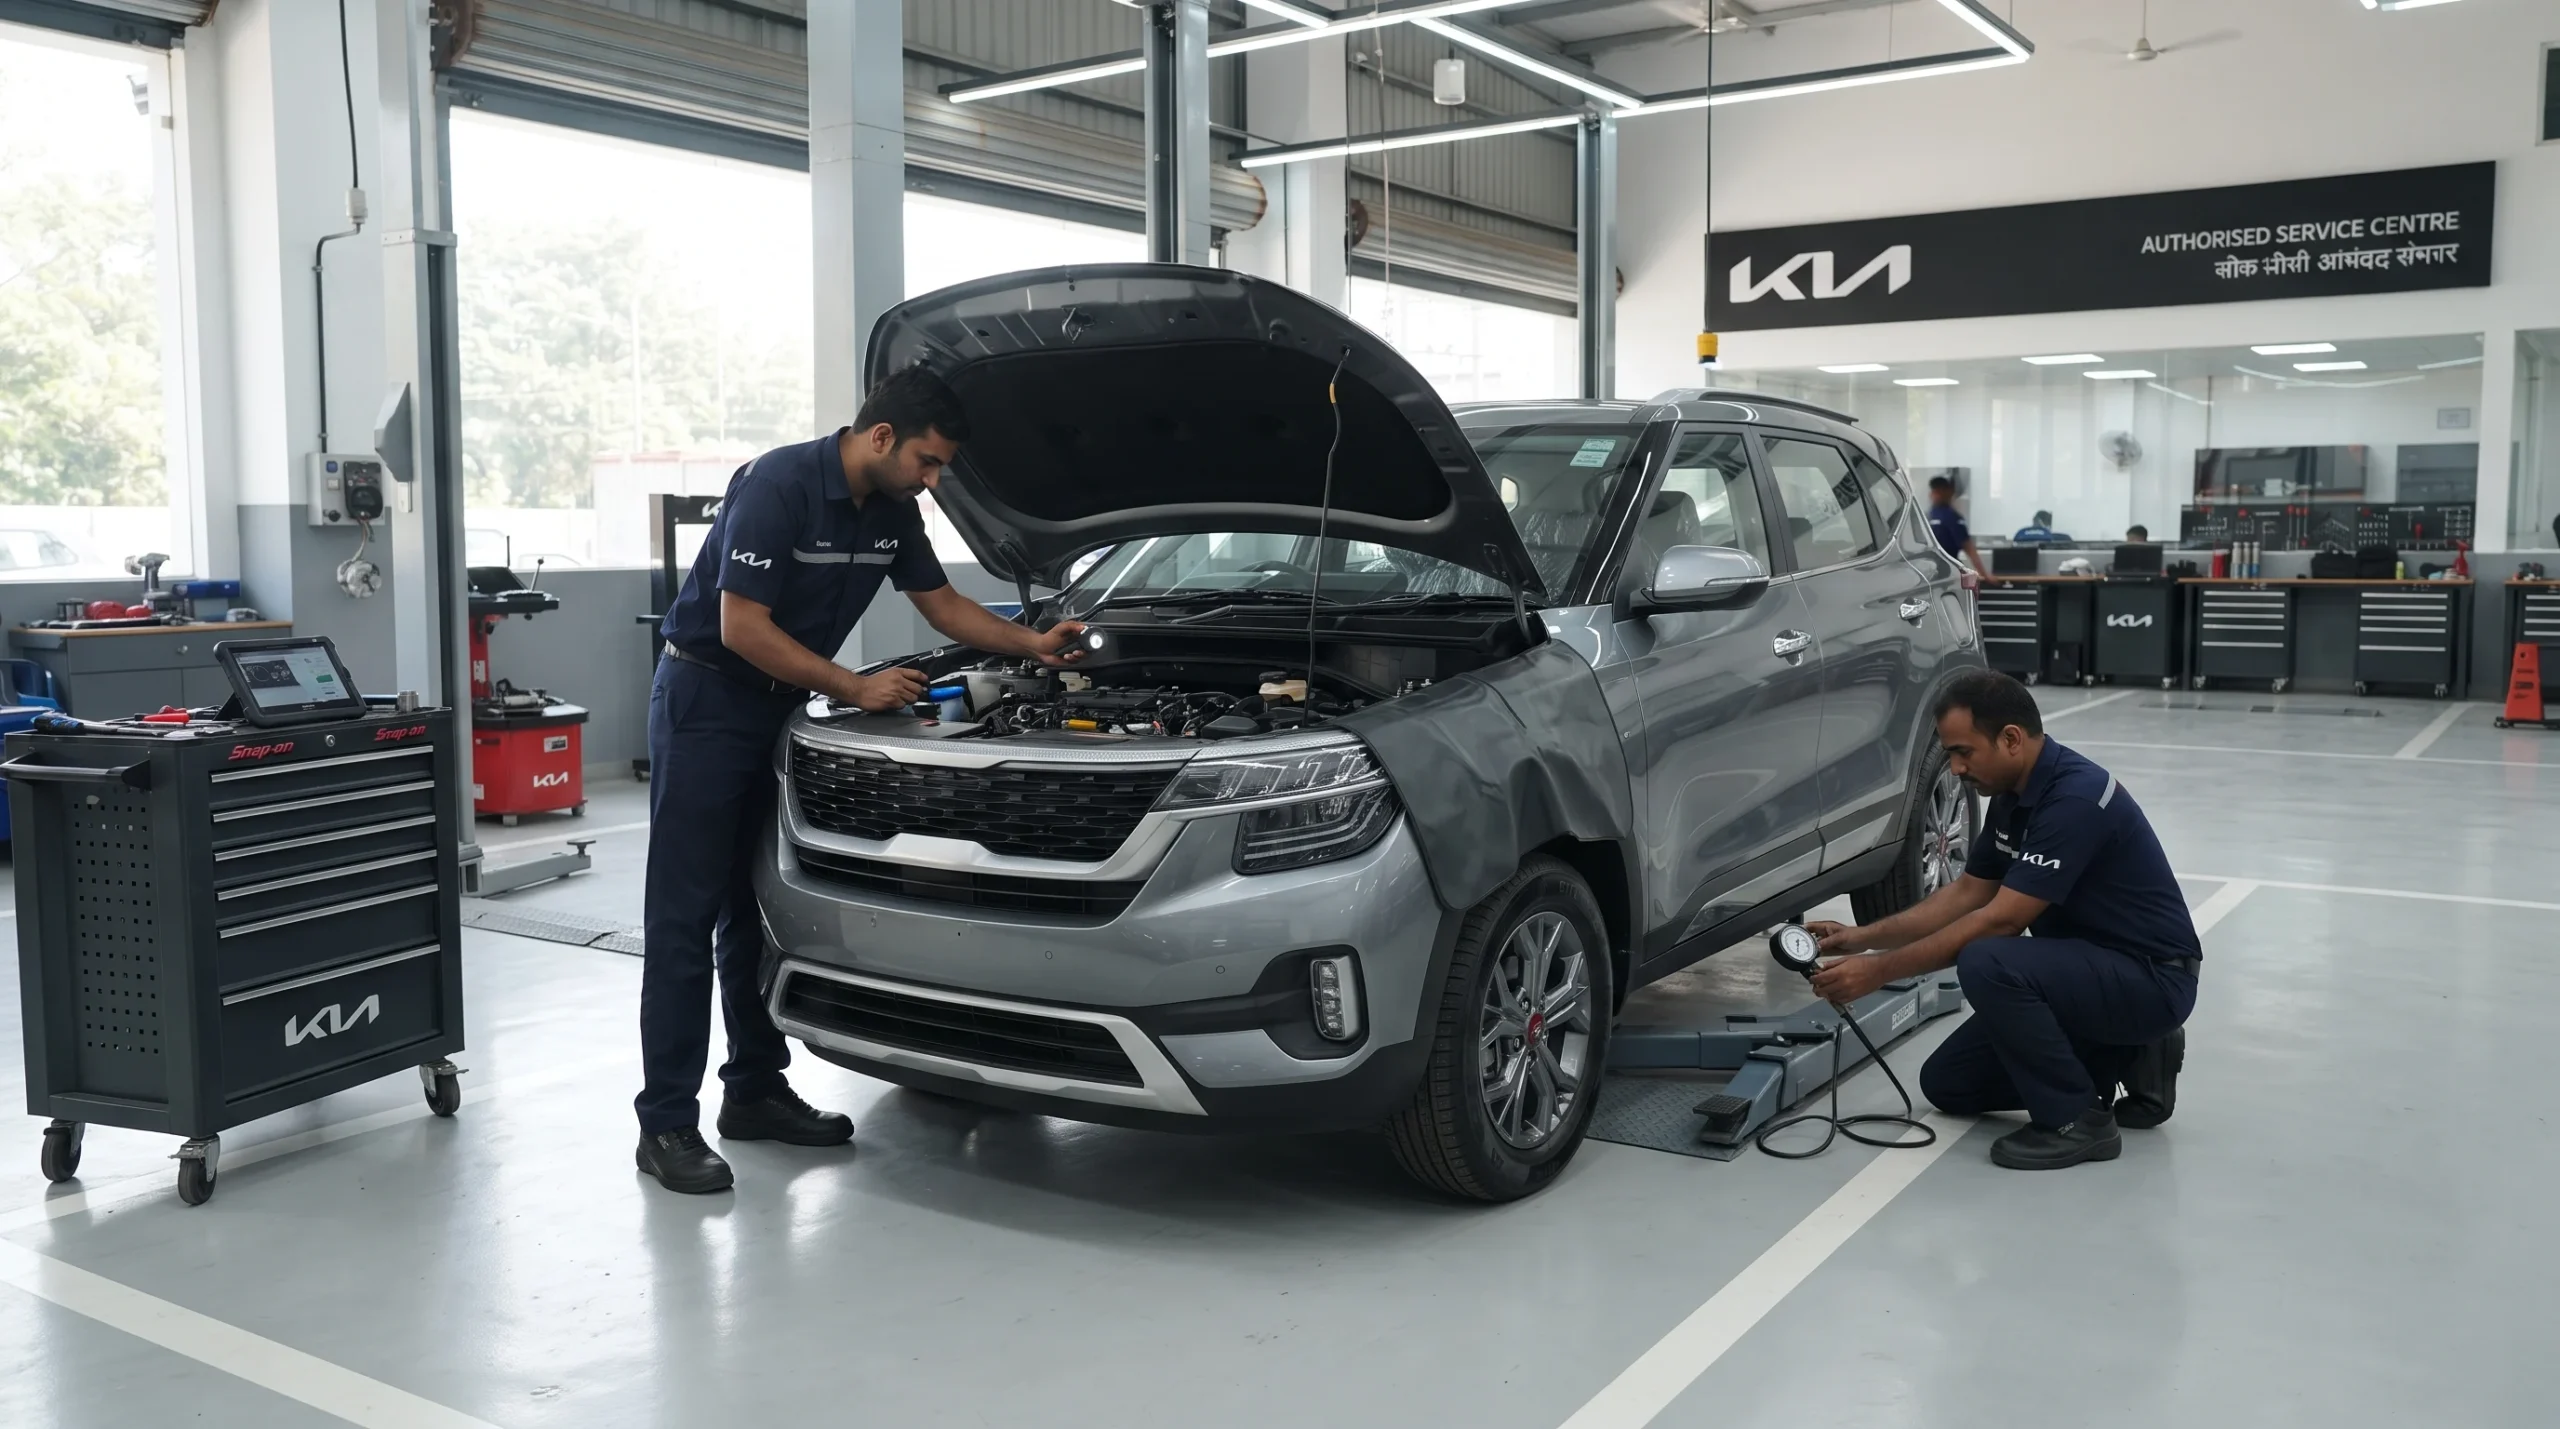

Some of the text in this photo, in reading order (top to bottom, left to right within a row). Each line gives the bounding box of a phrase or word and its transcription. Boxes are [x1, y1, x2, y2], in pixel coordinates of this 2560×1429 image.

[2141, 210, 2460, 254] AUTHORISED SERVICE CENTRE
[1729, 244, 1912, 304] KIA
[874, 538, 899, 549] KIA
[731, 548, 773, 570] KIA
[2106, 613, 2153, 628] KIA
[374, 725, 426, 742] Snap-on
[228, 741, 294, 761] Snap-on
[533, 771, 569, 788] KIA
[2021, 851, 2061, 869] KIA
[284, 993, 380, 1047] KIA
